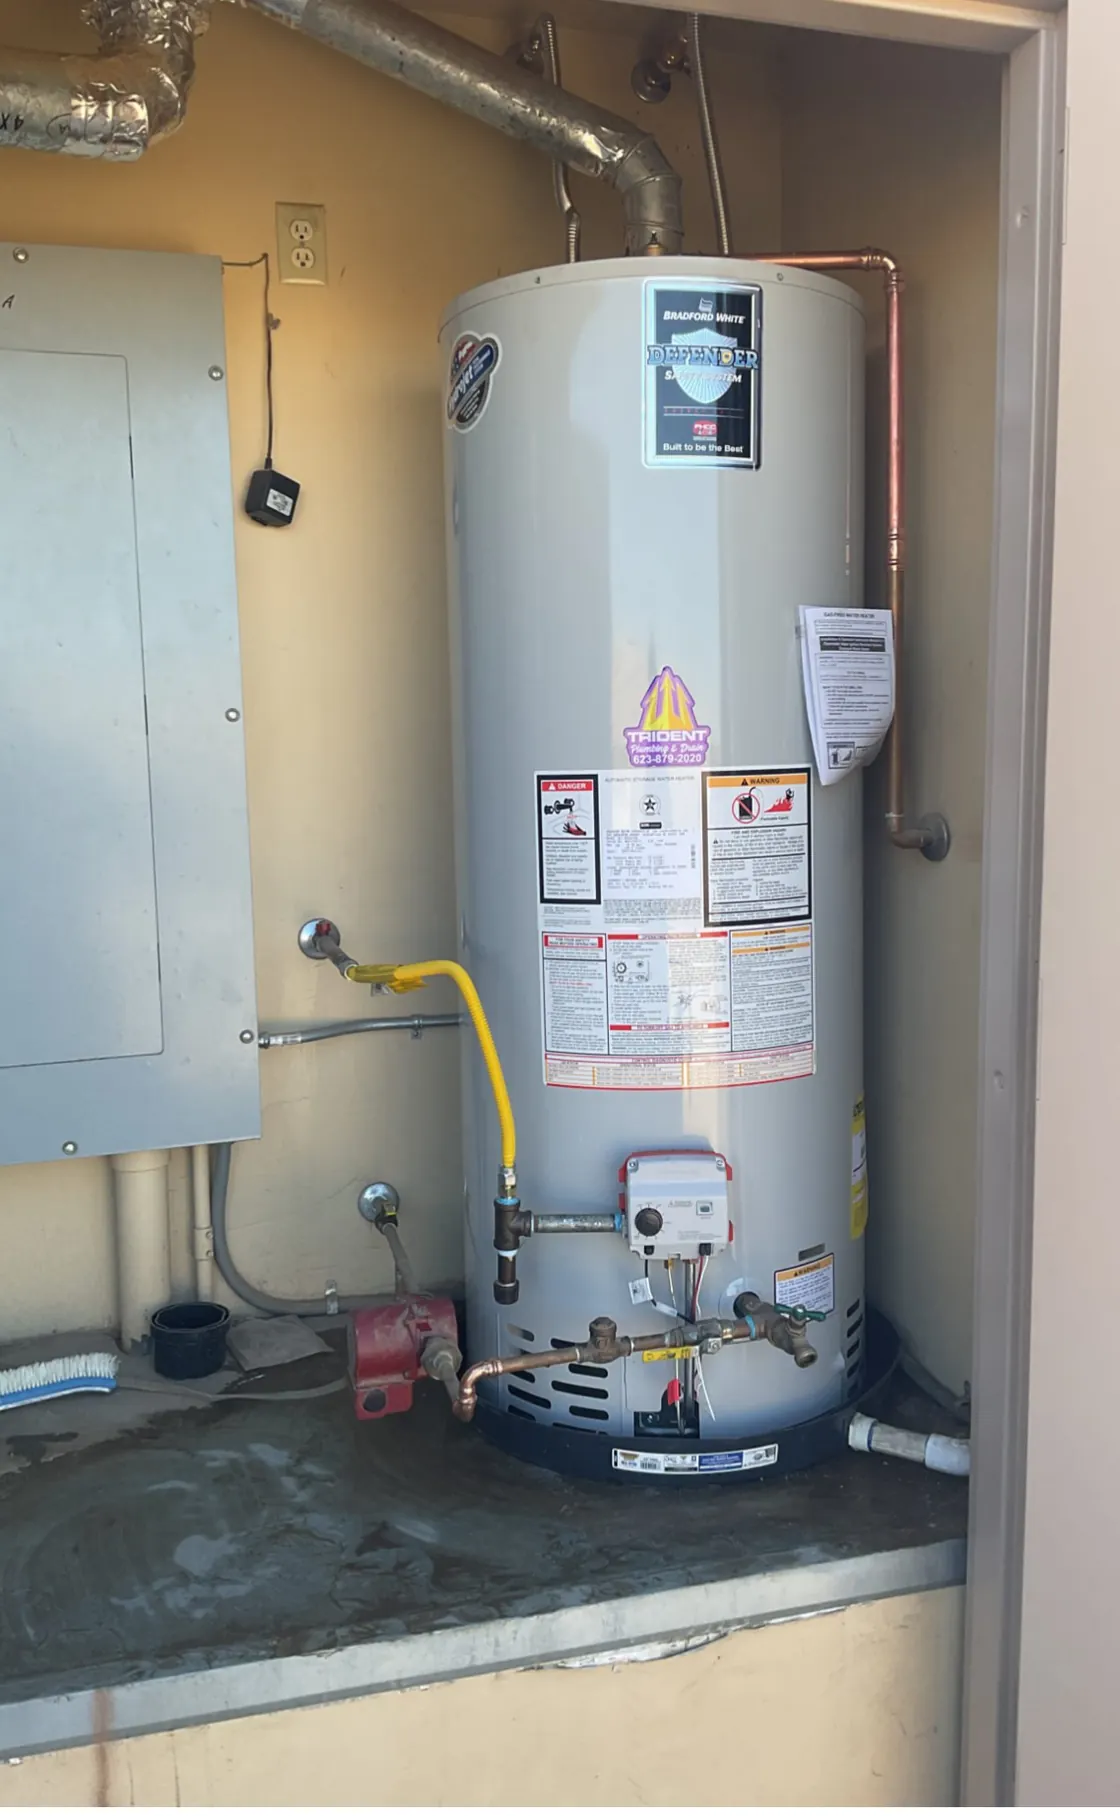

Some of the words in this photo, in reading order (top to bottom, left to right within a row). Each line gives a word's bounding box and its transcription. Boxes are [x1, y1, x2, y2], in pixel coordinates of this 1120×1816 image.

[2, 294, 15, 309] A
[663, 310, 714, 322] BRADFORD
[716, 312, 745, 324] WHITE
[648, 344, 759, 370] DEFENDER
[663, 443, 682, 451] Built
[684, 443, 694, 452] to
[695, 443, 707, 452] be
[708, 444, 723, 453] the
[724, 445, 743, 453] Best
[627, 730, 707, 743] TRIDENT
[631, 743, 670, 755] Plumbing
[671, 745, 678, 753] &
[680, 743, 704, 753] Drain
[633, 753, 702, 765] 623-879-2020
